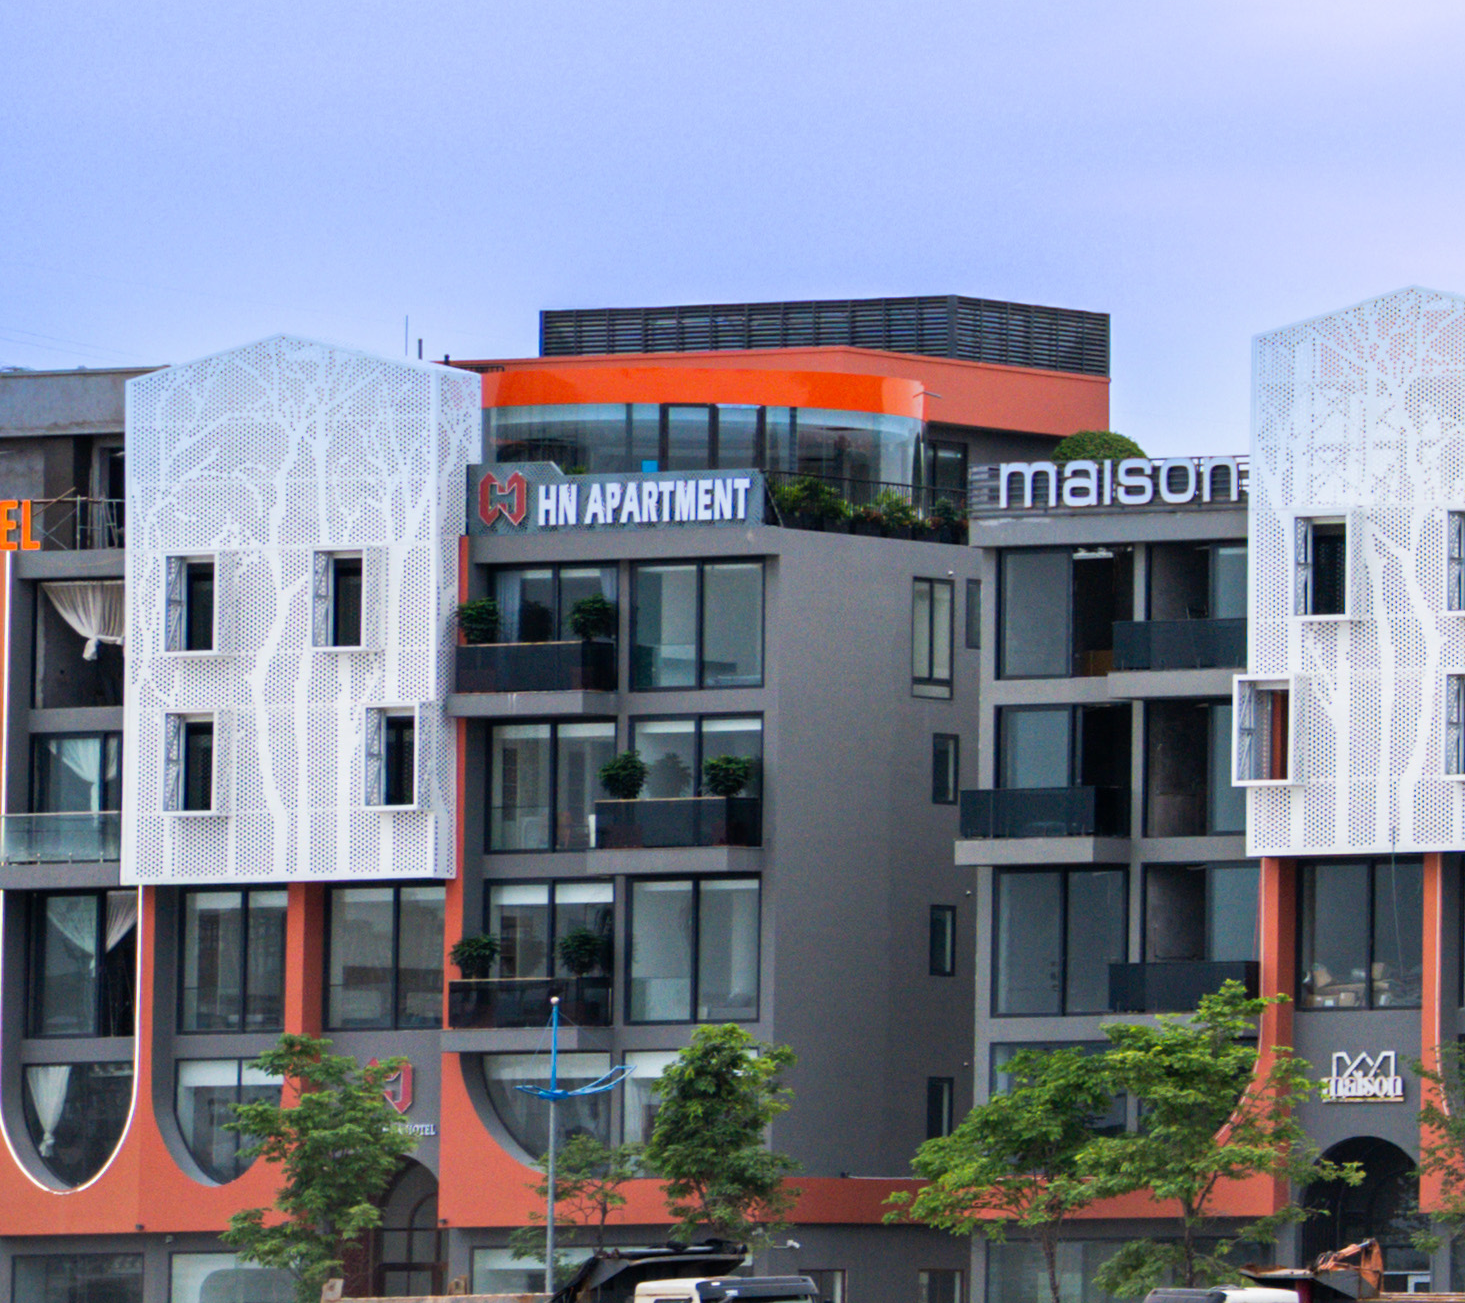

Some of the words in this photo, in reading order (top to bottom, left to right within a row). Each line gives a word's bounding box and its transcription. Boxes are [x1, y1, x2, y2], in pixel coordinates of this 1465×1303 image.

[538, 484, 578, 526] HN
[584, 477, 750, 524] APARTMENT
[999, 457, 1239, 509] maison
